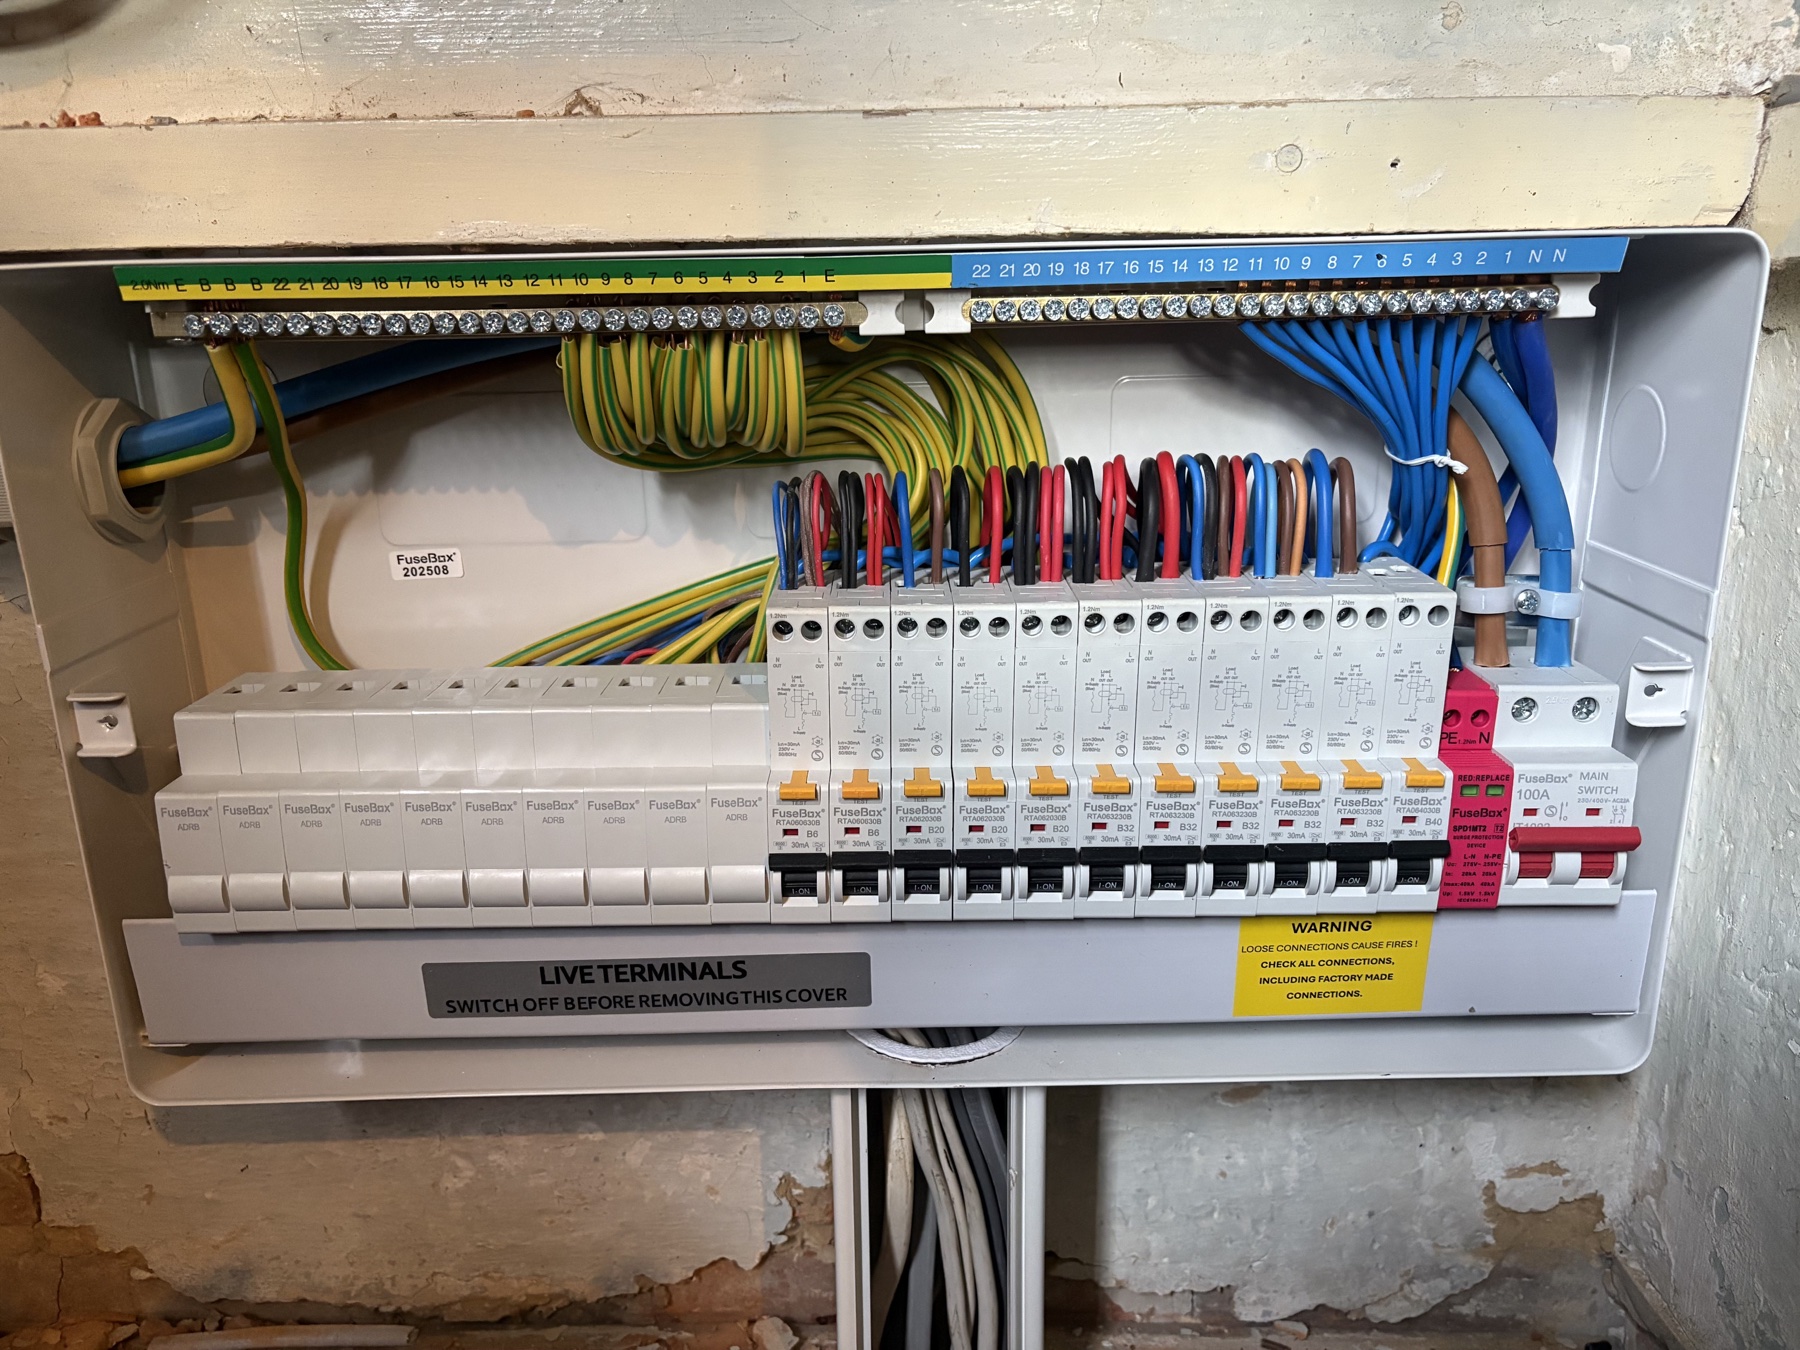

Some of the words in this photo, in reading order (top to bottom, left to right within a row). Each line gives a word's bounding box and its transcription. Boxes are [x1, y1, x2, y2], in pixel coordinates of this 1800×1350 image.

[972, 264, 990, 278] 22
[1000, 264, 1014, 277] 21
[1023, 263, 1040, 276] 20
[1048, 262, 1064, 276] 19
[1074, 262, 1090, 275] 18
[1098, 262, 1114, 274] 17
[1123, 260, 1139, 274] 16
[1148, 260, 1164, 273] 15
[1172, 260, 1188, 272] 14
[1198, 258, 1214, 272] 13
[1222, 258, 1238, 271] 12
[1249, 258, 1262, 270] 11
[1274, 257, 1290, 270] 10
[1301, 256, 1311, 270] 9
[1328, 256, 1337, 269] 8
[1353, 255, 1362, 268] 7
[1377, 254, 1387, 268] 6
[1402, 254, 1412, 266] 5
[1427, 253, 1436, 266] 4
[1452, 252, 1462, 265] 3
[1476, 252, 1487, 264] 2
[1506, 251, 1512, 263] 1
[1529, 250, 1542, 263] N
[1553, 249, 1566, 262] N
[131, 280, 169, 291] 2.0Nm
[174, 278, 187, 292] E
[200, 278, 212, 291] B
[224, 278, 236, 291] B
[251, 277, 263, 291] B
[272, 277, 291, 291] 22
[297, 277, 314, 290] 21
[321, 276, 339, 290] 20
[346, 276, 363, 290] 19
[371, 276, 388, 290] 18
[397, 276, 412, 289] 17
[423, 276, 440, 289] 16
[448, 275, 464, 288] 15
[472, 275, 488, 288] 14
[496, 274, 513, 288] 13
[523, 274, 540, 287] 12
[548, 273, 562, 286] 11
[572, 272, 589, 286] 10
[601, 272, 610, 285] 9
[623, 272, 633, 285] 8
[648, 272, 658, 284] 7
[673, 271, 683, 284] 6
[698, 271, 708, 284] 5
[723, 271, 732, 283] 4
[748, 270, 757, 283] 3
[774, 270, 784, 283] 2
[800, 270, 806, 282] 1
[825, 269, 835, 282] E
[402, 565, 449, 577] 202508
[1440, 732, 1458, 744] PE
[1479, 732, 1490, 744] N
[1580, 772, 1609, 780] MAIN
[1517, 789, 1550, 800] 100A
[1578, 786, 1618, 795] SWITCH
[300, 820, 322, 828] ADRB
[421, 818, 443, 826] ADRB
[481, 818, 503, 826] ADRB
[603, 816, 626, 824] ADRB
[664, 816, 687, 824] ADRB
[1304, 820, 1322, 828] B32
[1425, 818, 1442, 826] B40
[239, 821, 260, 829] ADRB
[1052, 825, 1069, 833] B20
[1117, 824, 1134, 832] B32
[1180, 823, 1197, 831] B32
[1242, 822, 1259, 830] B32
[807, 830, 818, 838] B6
[868, 829, 880, 837] B6
[928, 826, 945, 834] B20
[1408, 829, 1426, 837] 30mA
[791, 841, 809, 849] 30mA
[1292, 920, 1373, 934] WARNING
[1241, 945, 1274, 953] LOOSE
[1276, 942, 1349, 952] CONNECTIONS
[1351, 941, 1384, 950] CAUSE
[1386, 940, 1412, 948] FIRES
[1261, 960, 1296, 969] CHECK
[1318, 957, 1395, 967] CONNECTIONS,
[539, 965, 595, 985] LIVE
[597, 960, 748, 984] TERMINALS
[1259, 976, 1316, 984] INCLUDING
[1318, 974, 1363, 983] FACTORY
[1365, 973, 1394, 981] MADE
[1286, 990, 1363, 1000] CONNECTIONS.
[446, 999, 518, 1014] SWITCH
[523, 997, 559, 1011] OFF
[564, 995, 635, 1010] BEFORE
[639, 991, 739, 1008] REMOVING
[740, 990, 782, 1004] THIS
[785, 988, 847, 1002] COVER
